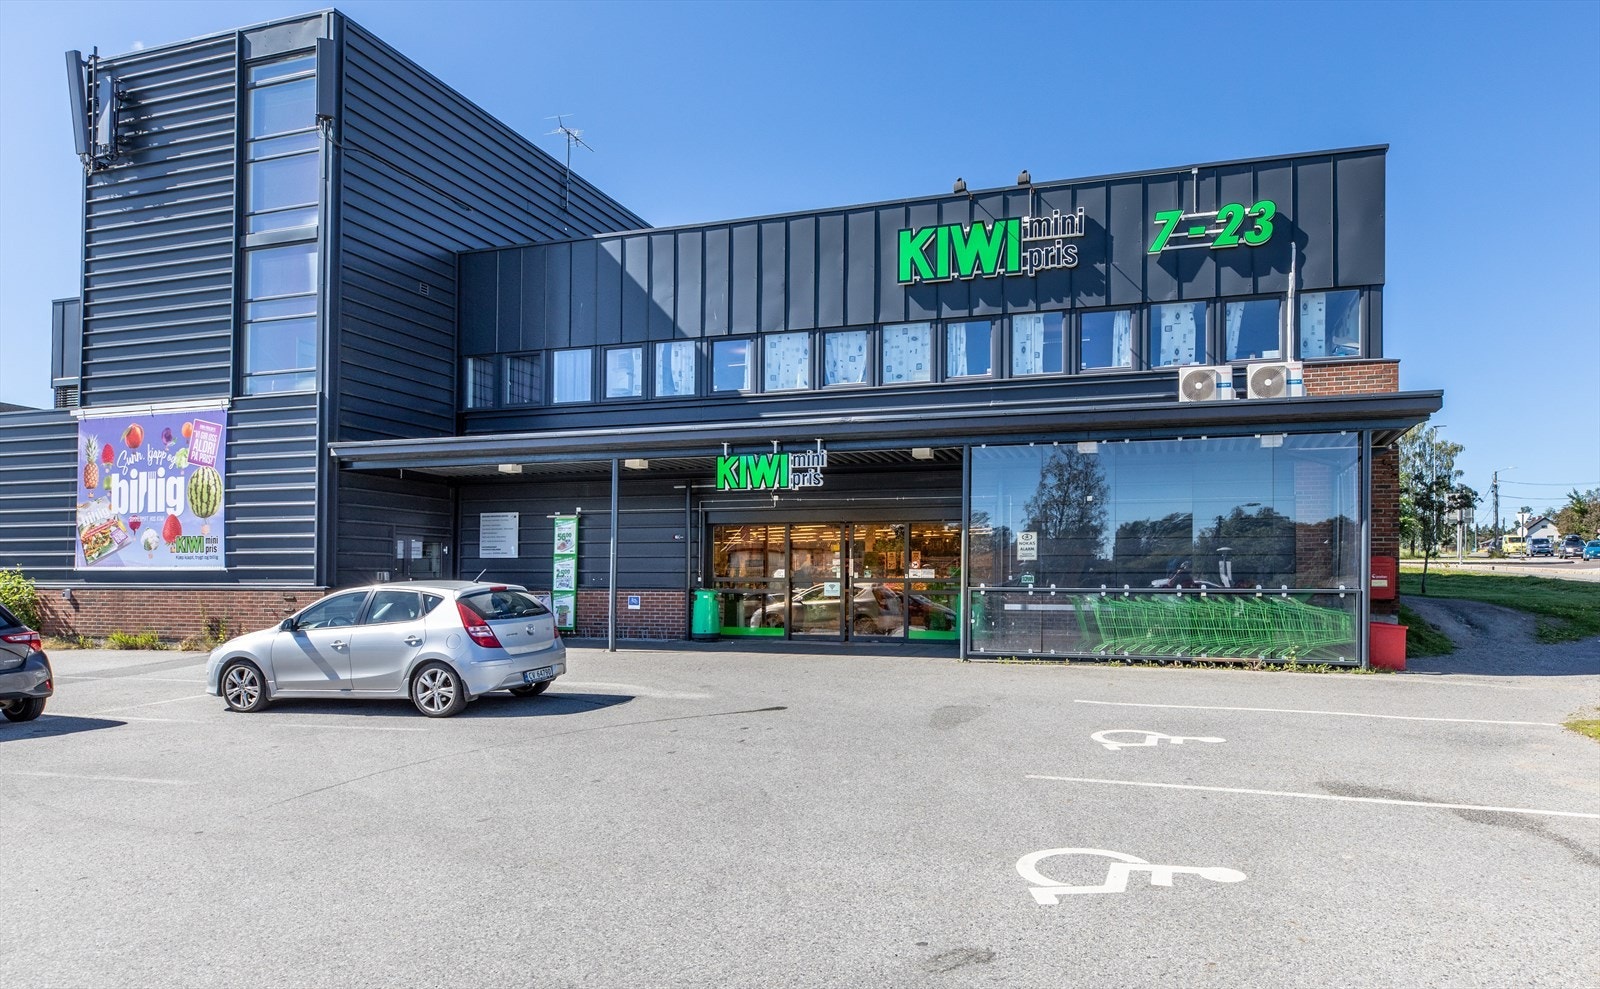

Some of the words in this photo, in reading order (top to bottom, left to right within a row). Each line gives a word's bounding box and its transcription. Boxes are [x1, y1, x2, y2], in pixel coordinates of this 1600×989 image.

[897, 216, 1024, 285] KIWI
[1028, 206, 1085, 241] mini
[1027, 239, 1078, 277] pris
[193, 439, 216, 455] ALDRI
[715, 453, 791, 491] KIWI
[791, 449, 828, 467] mini
[791, 467, 825, 491] pris
[111, 467, 185, 517] billig
[175, 535, 205, 554] KIWI
[205, 535, 219, 545] mini
[205, 544, 218, 555] pris
